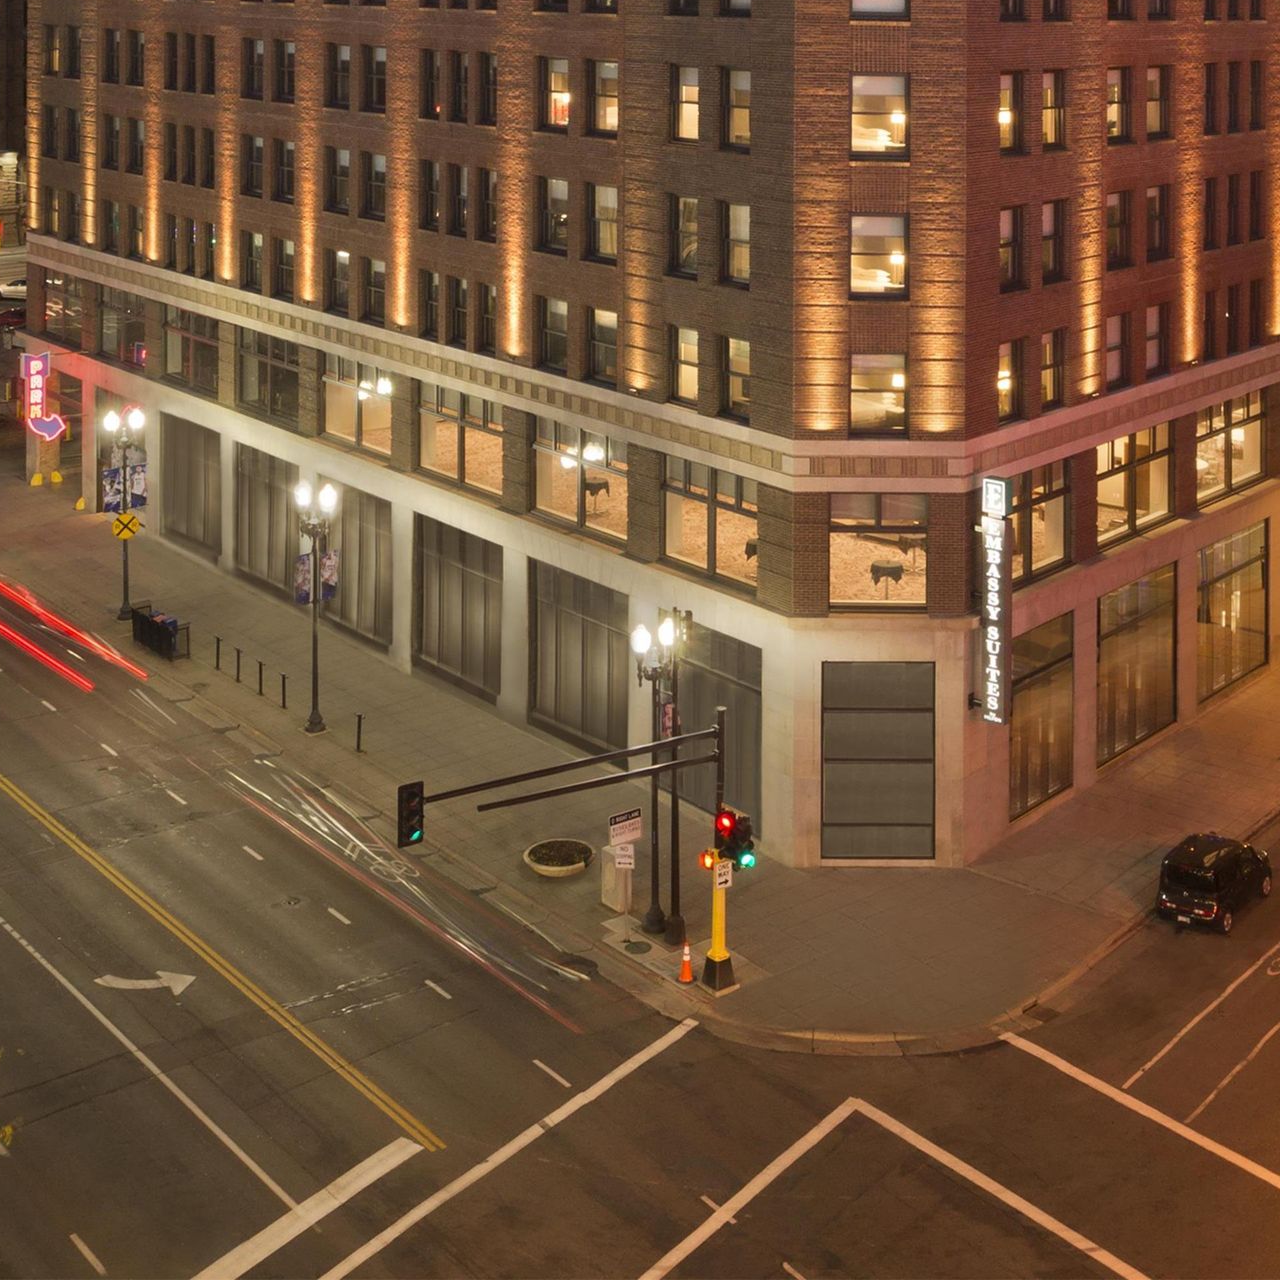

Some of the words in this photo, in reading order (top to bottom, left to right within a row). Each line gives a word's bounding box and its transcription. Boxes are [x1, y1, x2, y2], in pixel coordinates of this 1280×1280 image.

[29, 359, 44, 419] PARK
[985, 483, 1003, 512] E
[984, 521, 1003, 621] EMBASSY
[985, 626, 1002, 711] SUITES
